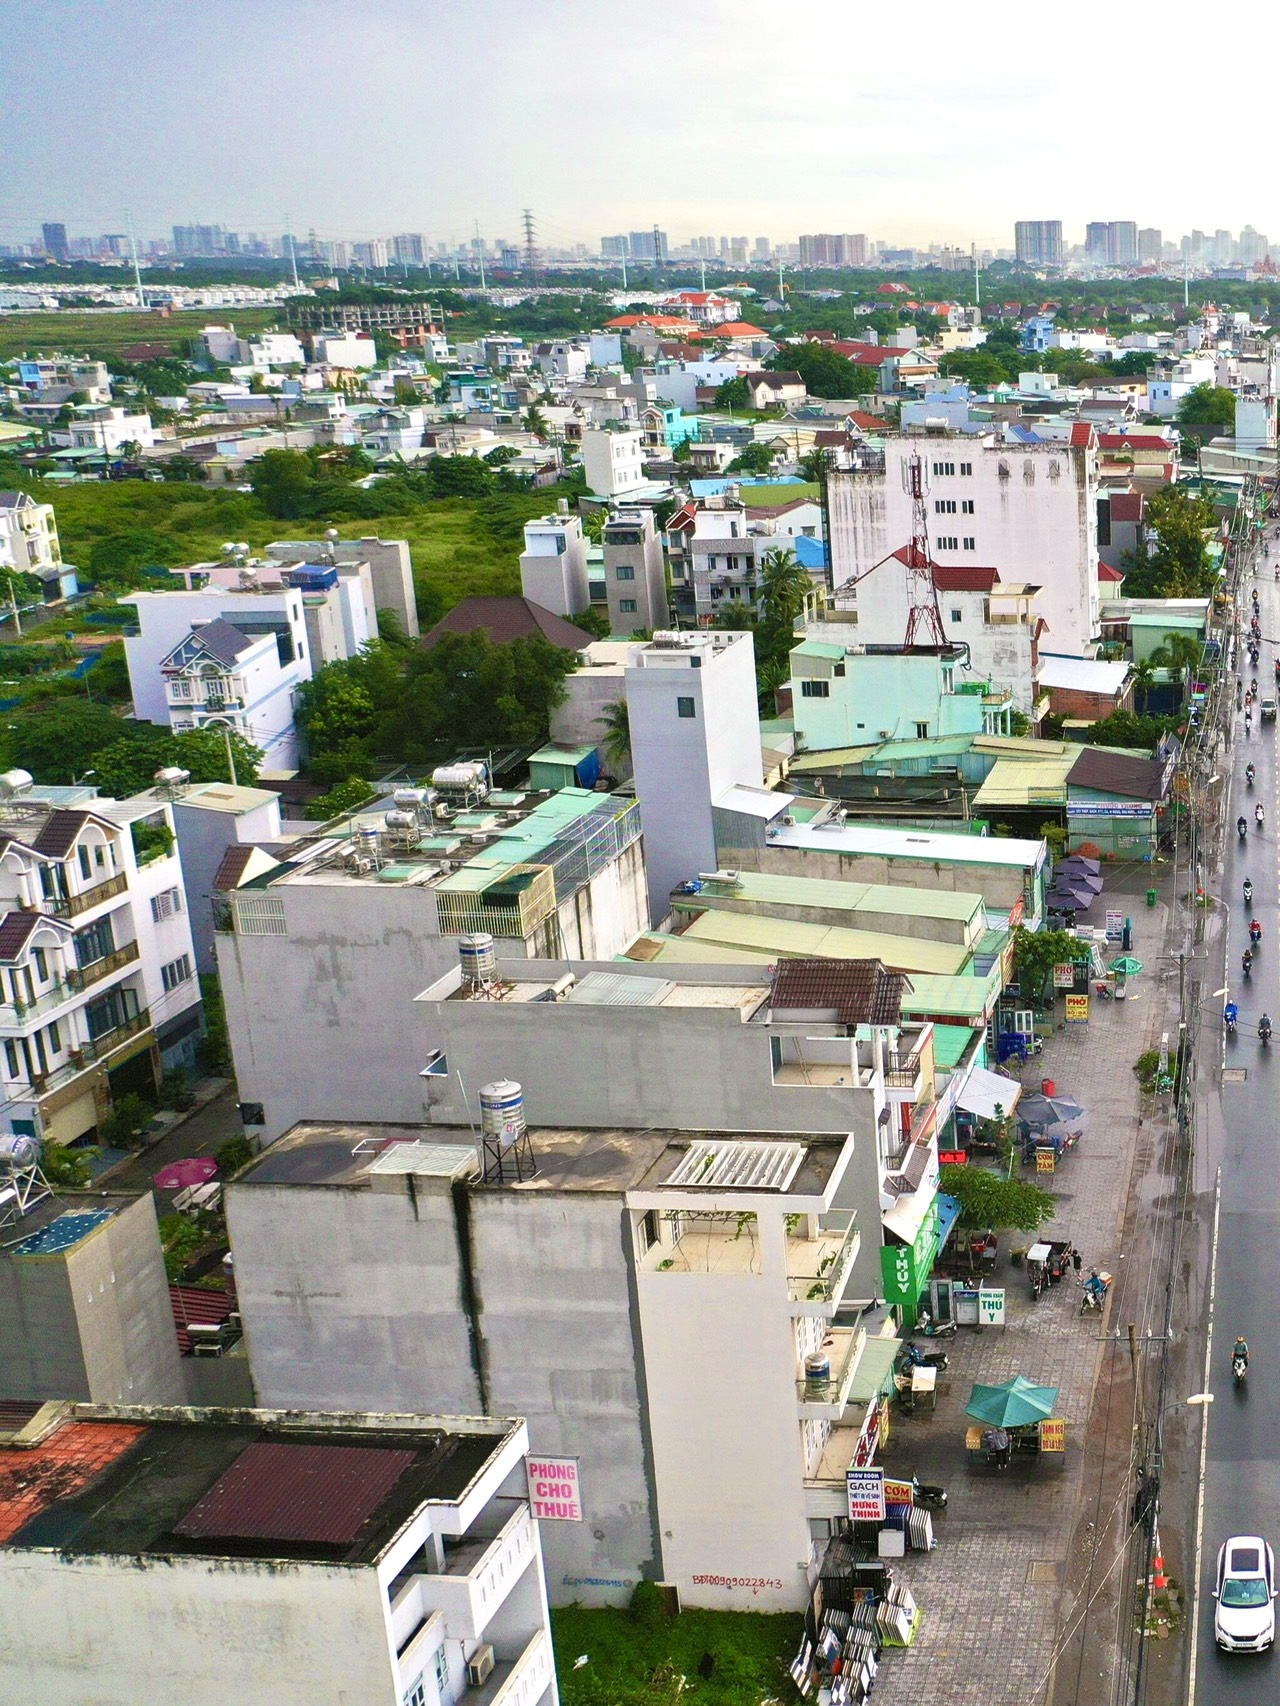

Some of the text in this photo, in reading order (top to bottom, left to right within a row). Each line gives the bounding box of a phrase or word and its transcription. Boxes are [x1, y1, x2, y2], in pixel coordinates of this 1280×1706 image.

[1068, 997, 1086, 1005] PHỞ
[981, 1299, 1002, 1310] THÚ
[988, 1313, 995, 1322] Y
[529, 1460, 575, 1480] PHÒNG
[536, 1482, 572, 1498] CHO
[885, 1486, 910, 1497] CƠM
[533, 1500, 579, 1519] THUÊ
[852, 1501, 878, 1509] HƯNG
[852, 1510, 880, 1518] THỊNH
